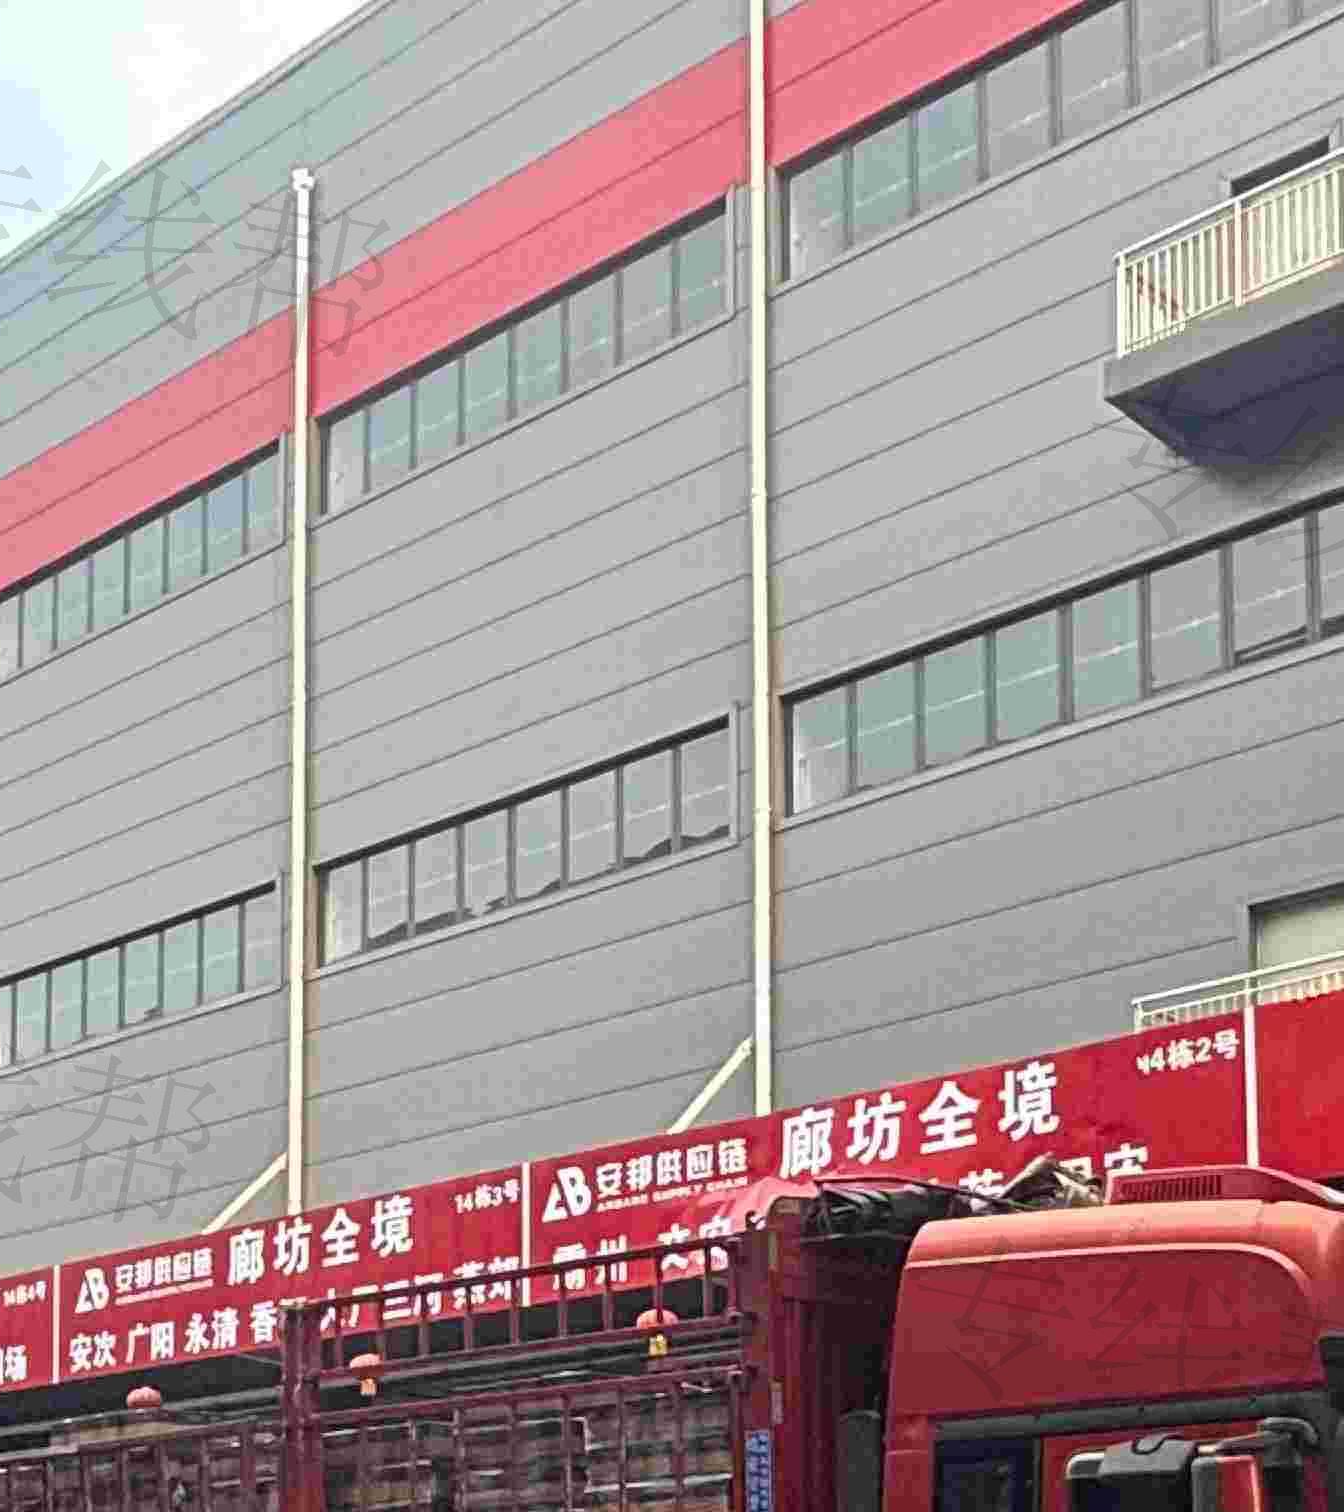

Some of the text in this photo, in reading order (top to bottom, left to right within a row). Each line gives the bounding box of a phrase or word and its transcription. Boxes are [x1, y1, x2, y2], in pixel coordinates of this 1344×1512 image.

[781, 1059, 1058, 1179] 廊坊全境
[596, 1138, 748, 1199] 安邦供应链
[227, 1194, 414, 1287] 廊坊全境
[68, 1330, 117, 1373] 安次
[126, 1321, 175, 1364] 广阳
[184, 1306, 239, 1355] 永清
